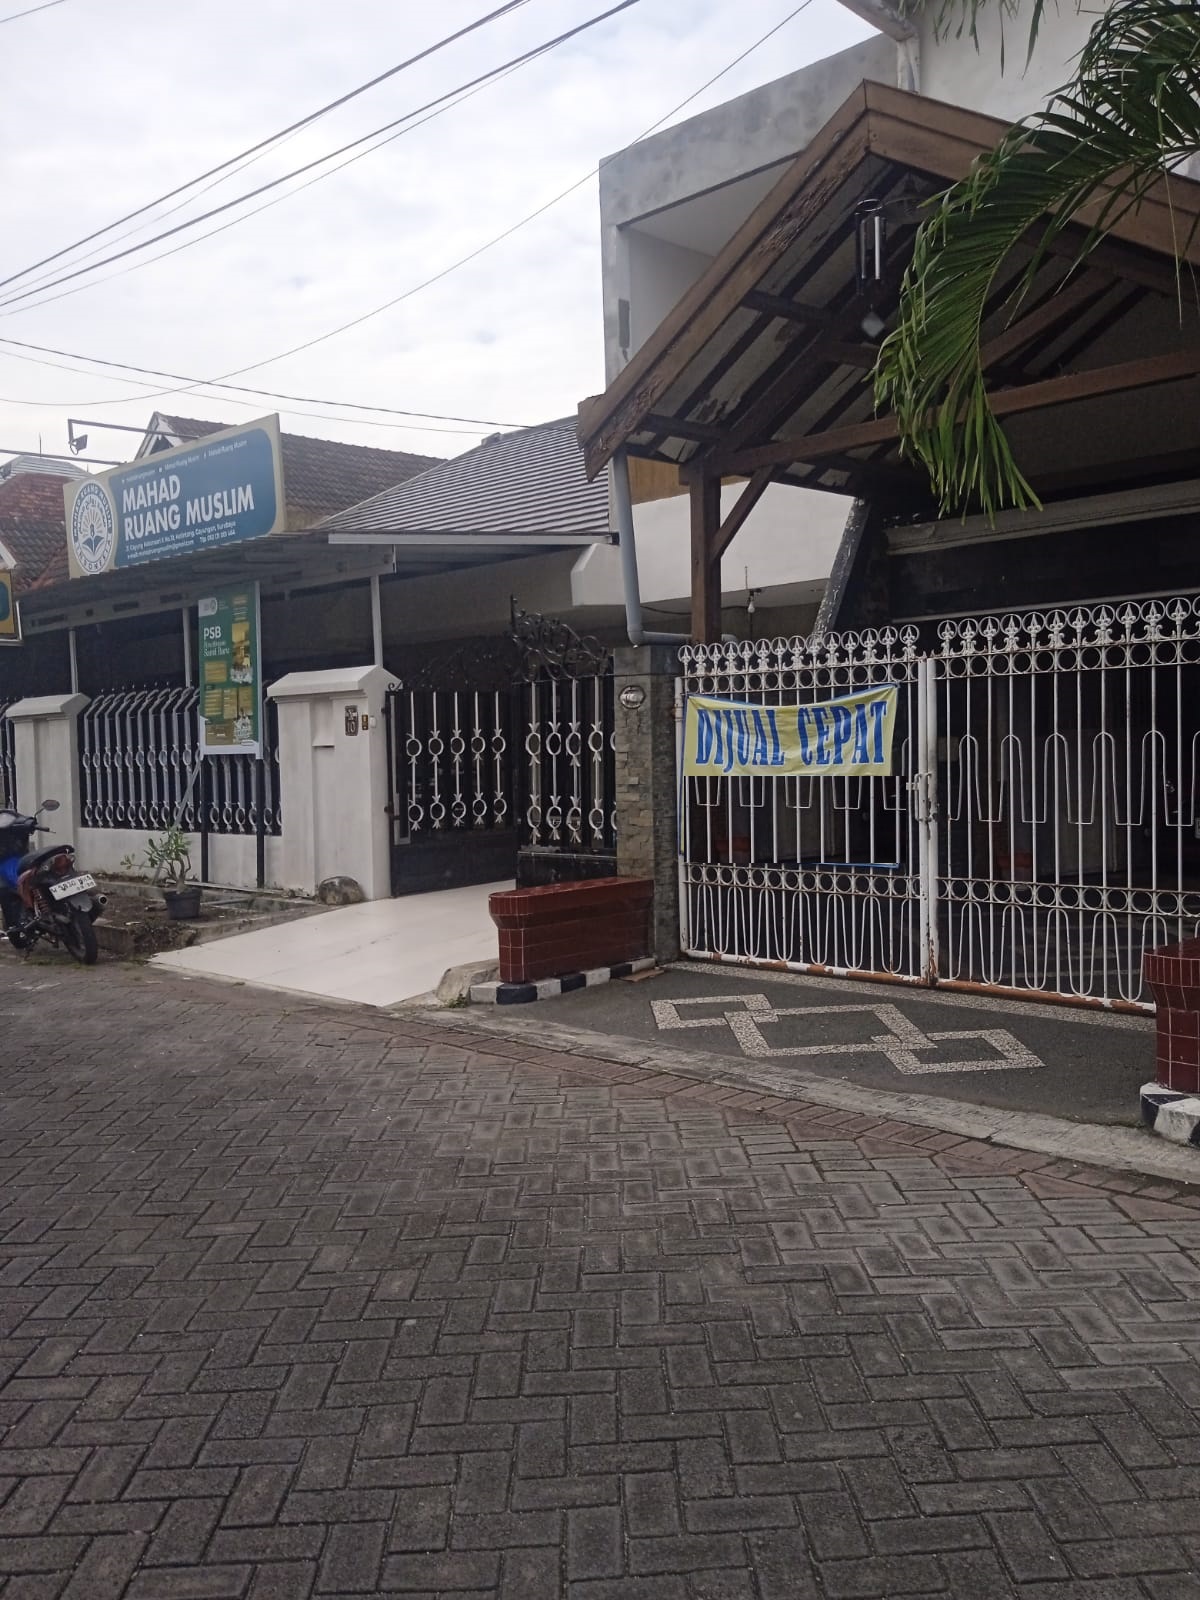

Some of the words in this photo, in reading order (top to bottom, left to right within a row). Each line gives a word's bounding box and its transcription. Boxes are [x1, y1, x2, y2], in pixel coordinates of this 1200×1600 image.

[122, 475, 180, 513] MAHAD
[124, 504, 180, 541] RUANG
[186, 484, 255, 526] MUSLIM
[203, 625, 222, 640] PSB
[696, 708, 784, 773] DIJUAL
[797, 701, 887, 765] CEPAT
